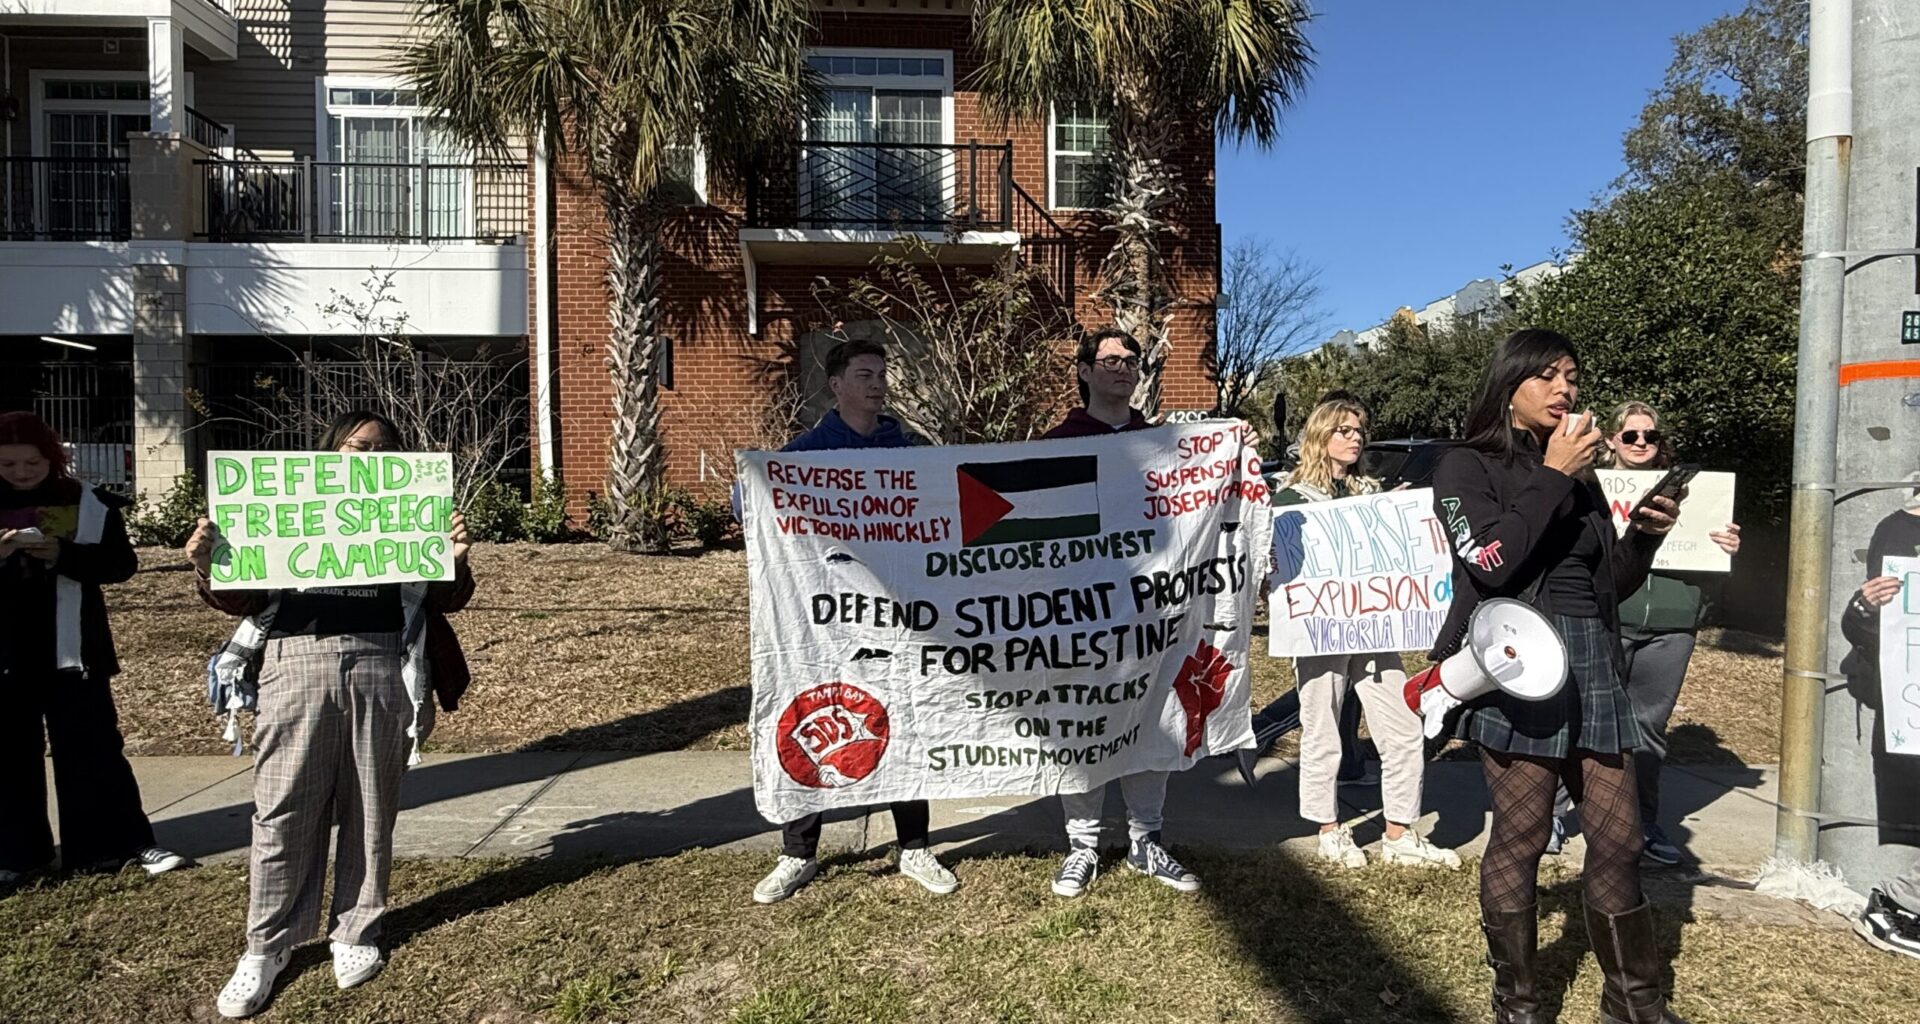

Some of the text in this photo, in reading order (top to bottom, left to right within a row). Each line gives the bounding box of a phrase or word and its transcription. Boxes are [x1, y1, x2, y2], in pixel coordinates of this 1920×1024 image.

[1177, 432, 1223, 460] STOP
[215, 454, 412, 497] DEFEND
[766, 460, 918, 491] REVERSE THE
[1145, 457, 1261, 492] SUSPENSIO O
[1603, 476, 1637, 495] RDS
[215, 500, 326, 538] FREE
[336, 494, 453, 536] SPEECH
[772, 488, 919, 519] EXPULSION OF
[1143, 488, 1218, 520] JOSEPH
[776, 516, 951, 544] VICTORIA HINCKLEY
[1275, 496, 1433, 579] REVERSE
[1420, 516, 1449, 555] TH
[211, 542, 267, 583] ON
[288, 536, 445, 579] CAMPUS
[926, 529, 1157, 577] DISCLOSE & DIVEST
[812, 593, 939, 632] DEFEND
[954, 582, 1116, 638] STUDENT
[1130, 553, 1247, 614] PROTESTS
[1285, 574, 1431, 619] EXPULSION
[920, 613, 1185, 676] FOR PALESTINE
[1304, 614, 1394, 653] VICTORIA
[844, 687, 866, 703] BAY
[965, 673, 1150, 709] STOP ATTACKS
[800, 706, 854, 754] SDS
[1014, 716, 1107, 738] ON THE
[928, 723, 1140, 772] STUDENT MOVEMENT
